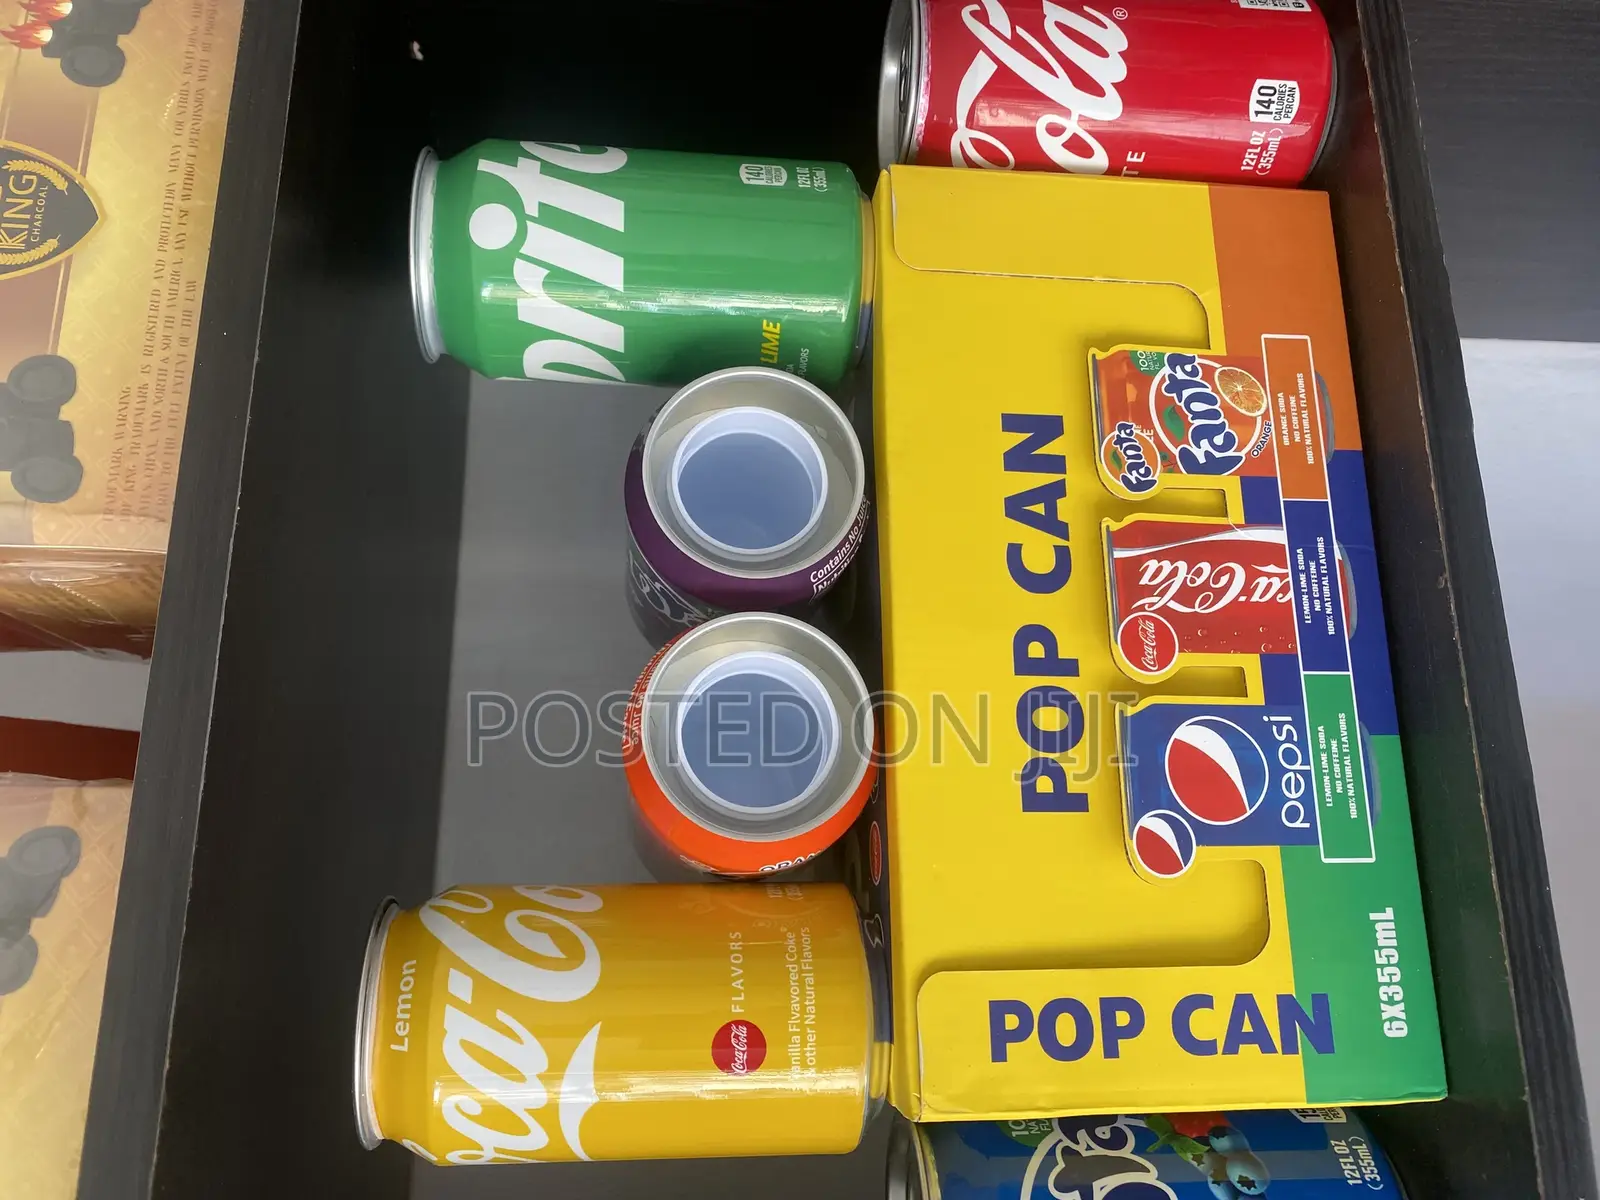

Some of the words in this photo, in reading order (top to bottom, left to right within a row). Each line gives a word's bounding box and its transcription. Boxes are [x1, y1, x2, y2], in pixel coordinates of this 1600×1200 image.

[1254, 85, 1277, 117] 140
[1273, 83, 1288, 121] CALORIES
[1256, 128, 1284, 175] (355mL)
[745, 165, 764, 182] 140
[0, 174, 37, 249] KING
[31, 185, 48, 242] CHARCOAL
[143, 288, 163, 357] REGISTERED
[1276, 391, 1286, 413] SODA
[1296, 372, 1308, 407] FLAVORS
[113, 385, 132, 441] WARNING
[1162, 351, 1245, 475] Fanta
[1279, 414, 1291, 446] ORANGE
[1288, 394, 1300, 430] COFFEINE
[1300, 408, 1313, 445] NATURAL
[1112, 421, 1158, 492] Fanta
[1250, 420, 1273, 457] ORANGE
[1293, 431, 1302, 443] NO
[1305, 445, 1315, 465] 100%
[1001, 412, 1073, 595] CAN
[810, 542, 851, 583] Contains
[848, 525, 860, 544] No
[855, 494, 867, 526] Juice
[1296, 547, 1306, 571] SODA
[1316, 536, 1328, 574] FLAVORS
[1299, 571, 1312, 624] LEMON-LIME
[1308, 559, 1320, 598] COFFEINE
[1321, 575, 1333, 615] NATURAL
[1313, 599, 1322, 612] NO
[1325, 615, 1336, 635] 100%
[631, 711, 643, 745] Juice
[1012, 623, 1089, 813] POP
[1317, 725, 1327, 750] SODA
[1338, 712, 1350, 753] FLAVORS
[1262, 715, 1311, 828] pepsi
[1320, 751, 1333, 807] LEMON-LIME
[1330, 738, 1342, 779] COFFEINE
[1344, 754, 1356, 797] NATURAL
[1335, 780, 1344, 794] NO
[1348, 797, 1358, 819] 100%
[799, 926, 815, 970] Flavors
[729, 931, 745, 1013] FLAVORS
[1369, 907, 1408, 1038] 6X355mL
[390, 959, 417, 1052] Lemon
[801, 972, 817, 1024] Natural
[801, 1028, 817, 1065] other
[988, 995, 1146, 1064] POP
[1171, 992, 1336, 1057] CAN
[1348, 1136, 1384, 1191] (355mL)
